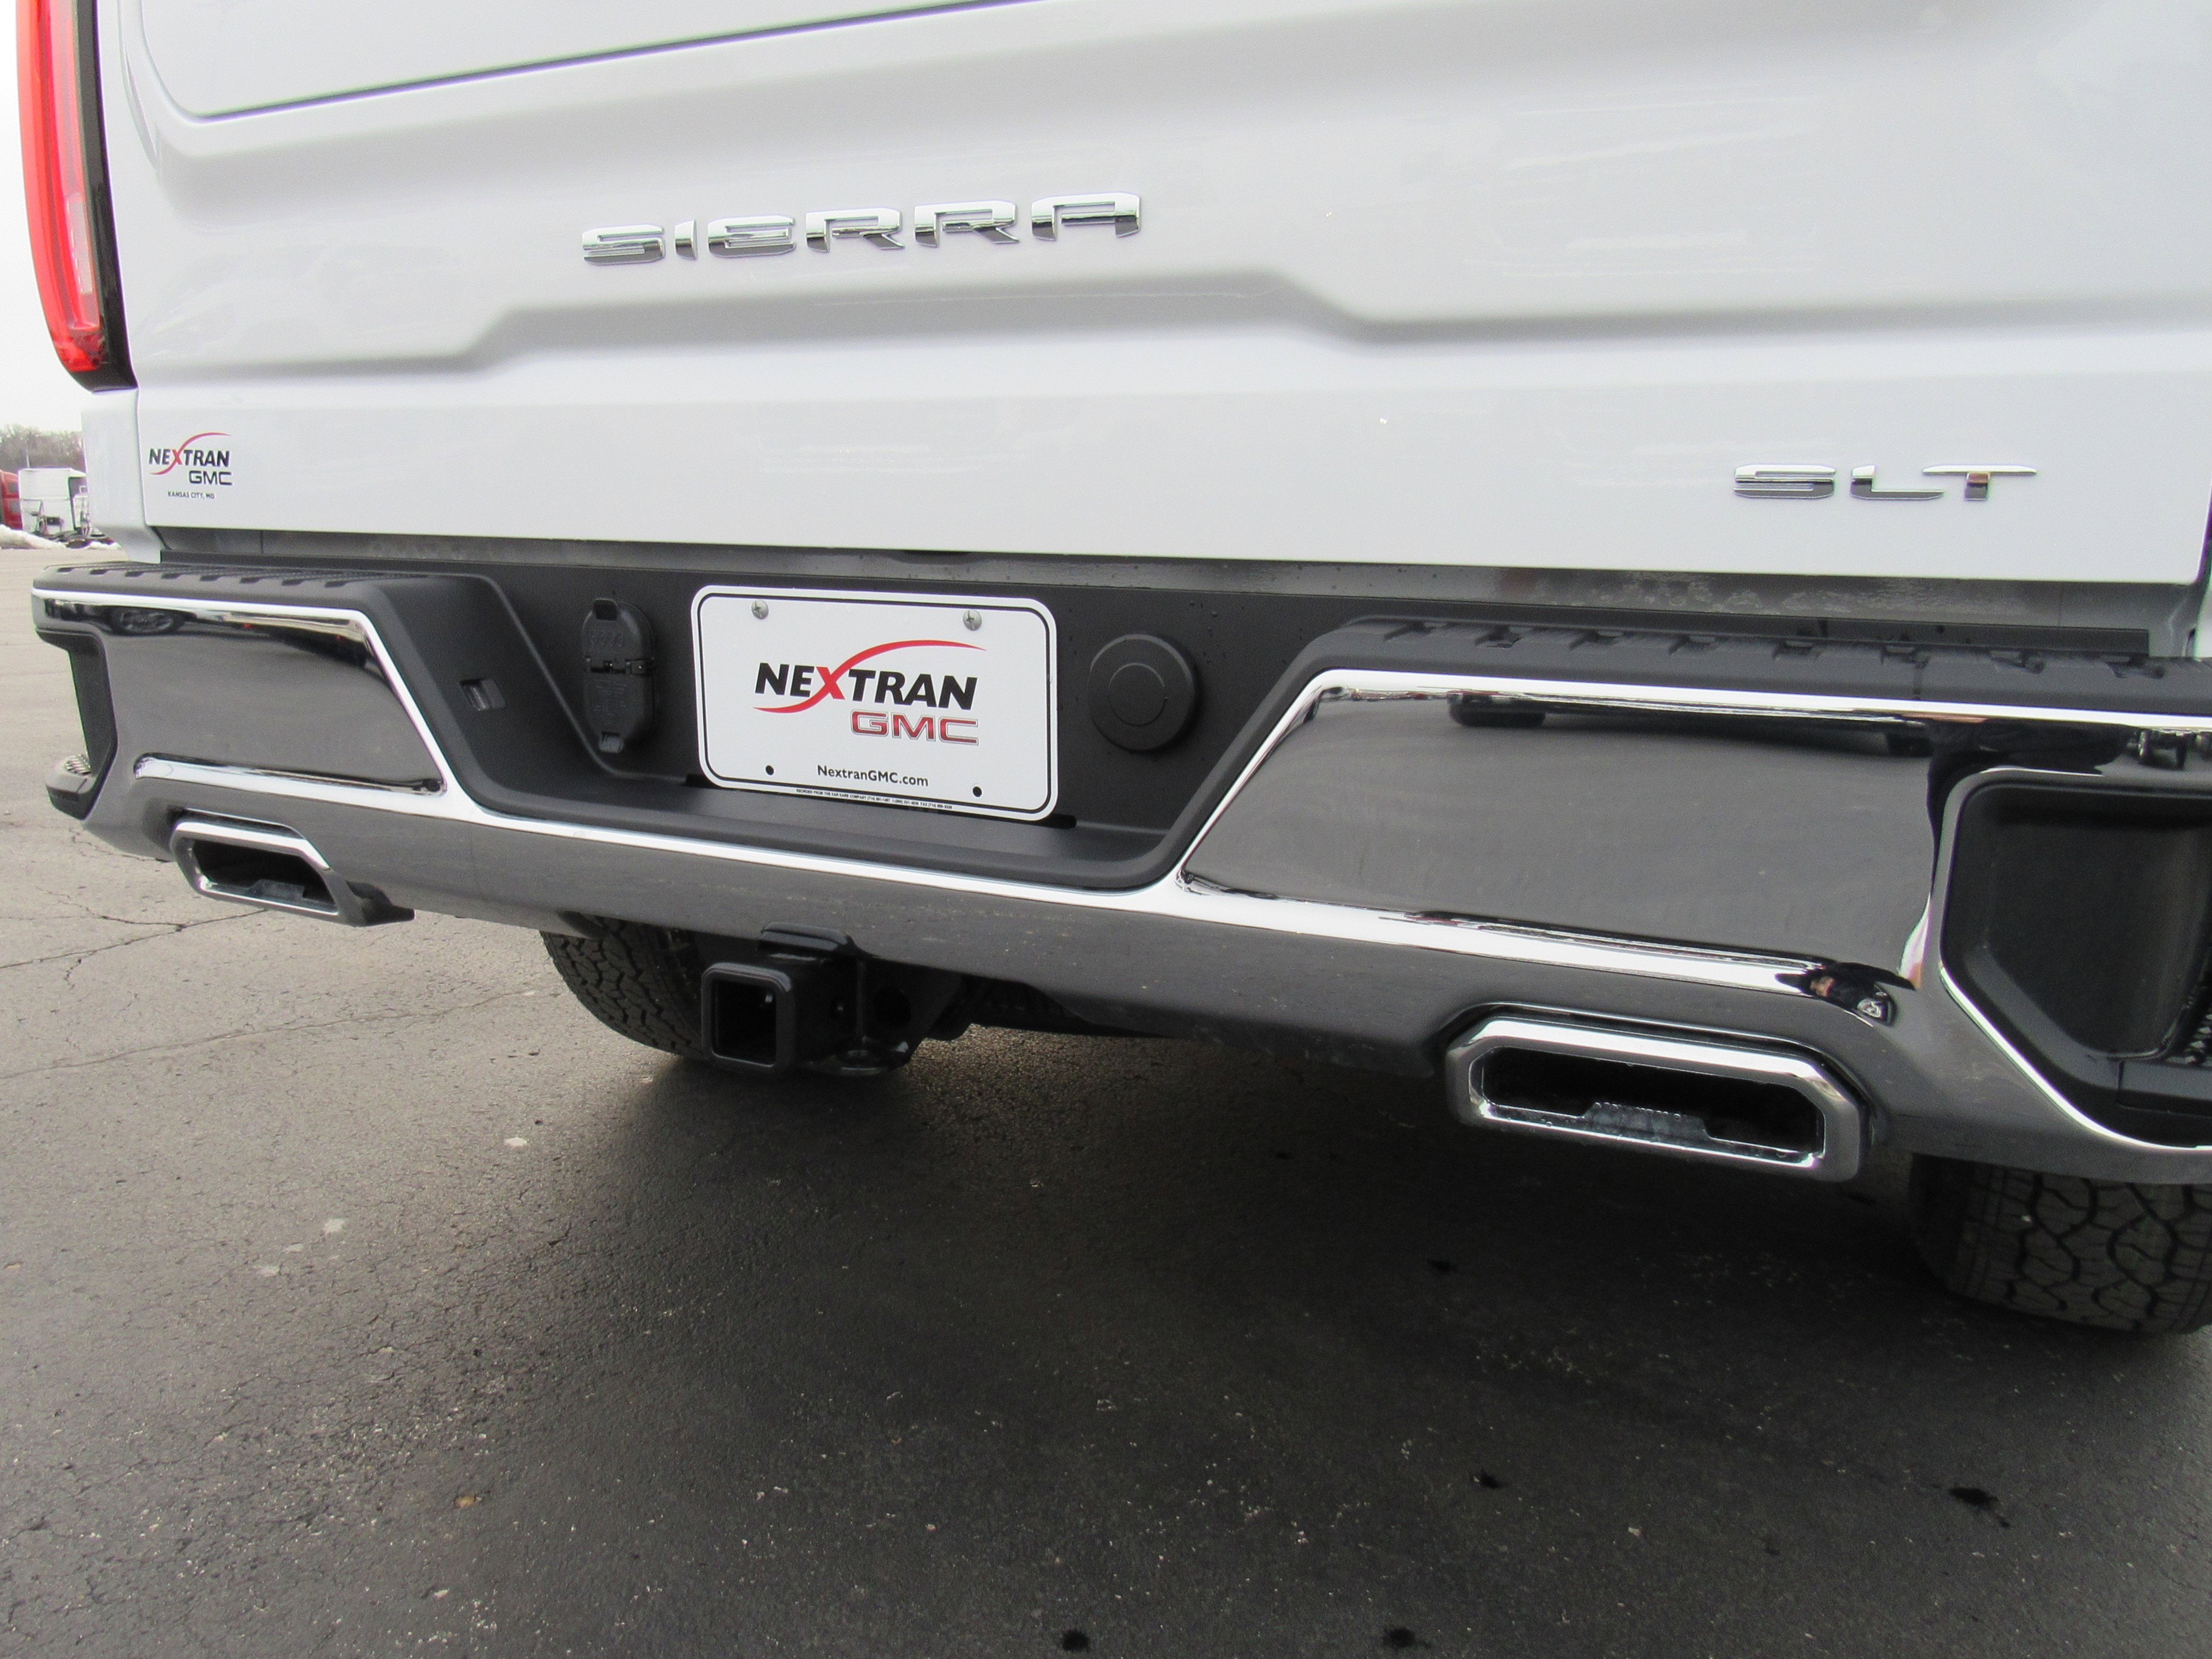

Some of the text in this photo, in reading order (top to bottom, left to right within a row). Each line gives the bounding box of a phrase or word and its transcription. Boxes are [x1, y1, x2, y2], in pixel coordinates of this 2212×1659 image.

[581, 192, 1141, 264] SIERRA
[148, 448, 231, 467] NEXTRAN
[188, 470, 233, 485] GMC
[1734, 464, 2037, 501] SLT
[754, 662, 977, 710] NEXTRAN
[850, 709, 979, 746] GMC
[817, 764, 929, 787] NextranGMC.com
